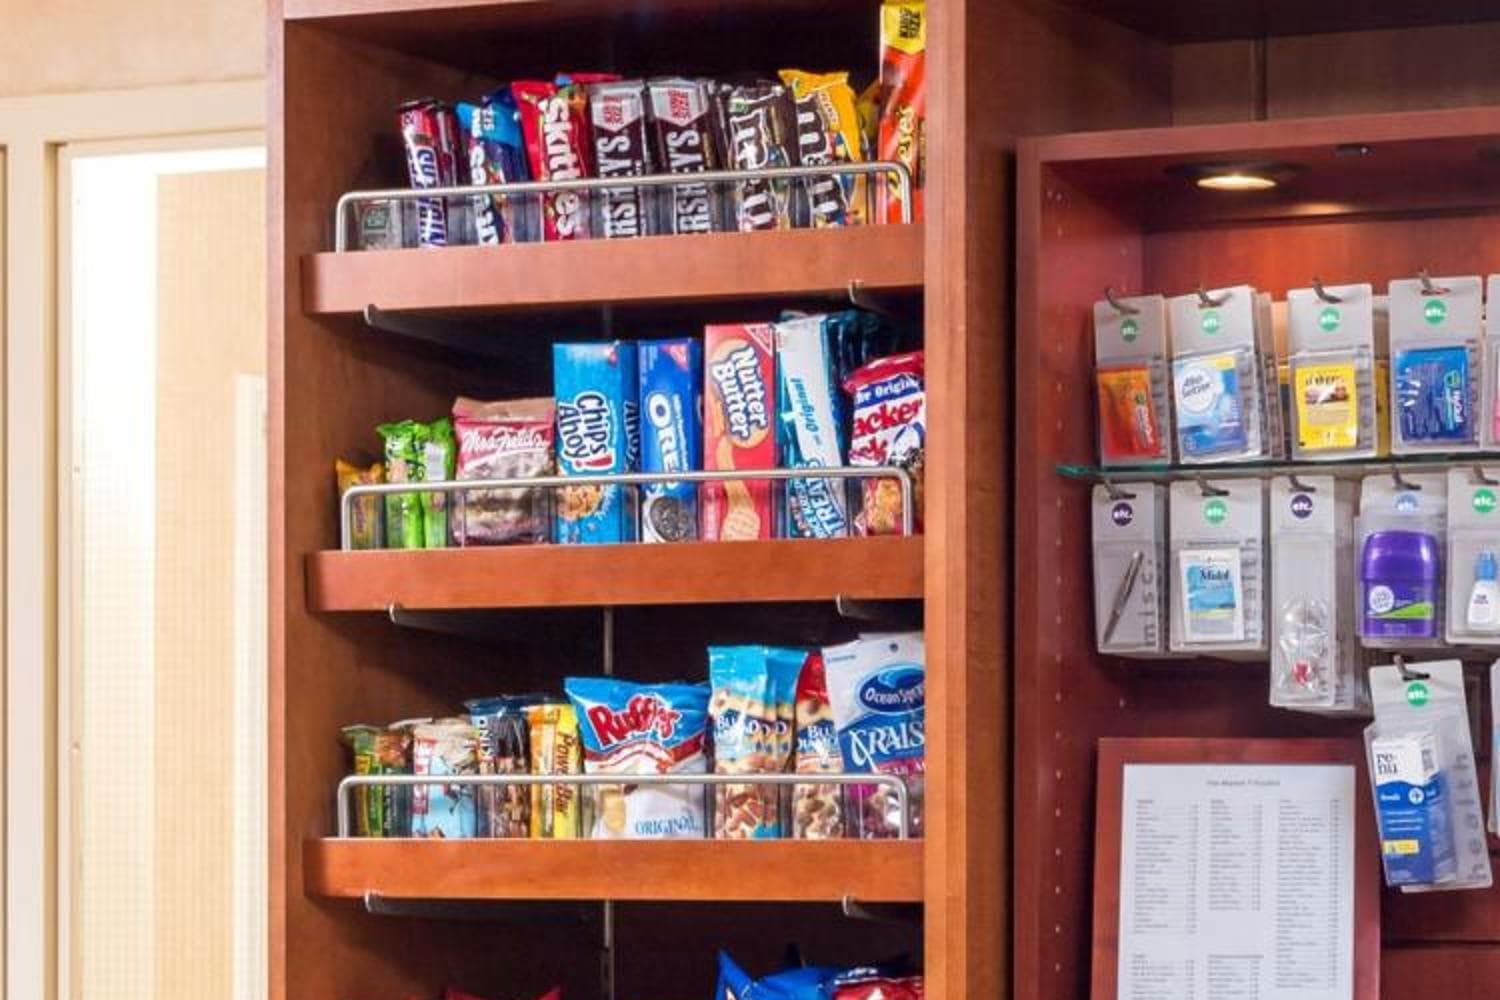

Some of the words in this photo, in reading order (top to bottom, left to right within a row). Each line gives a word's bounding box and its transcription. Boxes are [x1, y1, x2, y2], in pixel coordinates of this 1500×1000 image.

[597, 134, 637, 238] RSHEY'S
[667, 130, 710, 232] RSHEY'S
[711, 361, 751, 440] Butter
[732, 346, 768, 430] Nutter
[575, 393, 610, 454] Chips
[587, 694, 683, 750] Ruffles
[864, 687, 901, 703] Ocean
[850, 721, 925, 770] CRAIS
